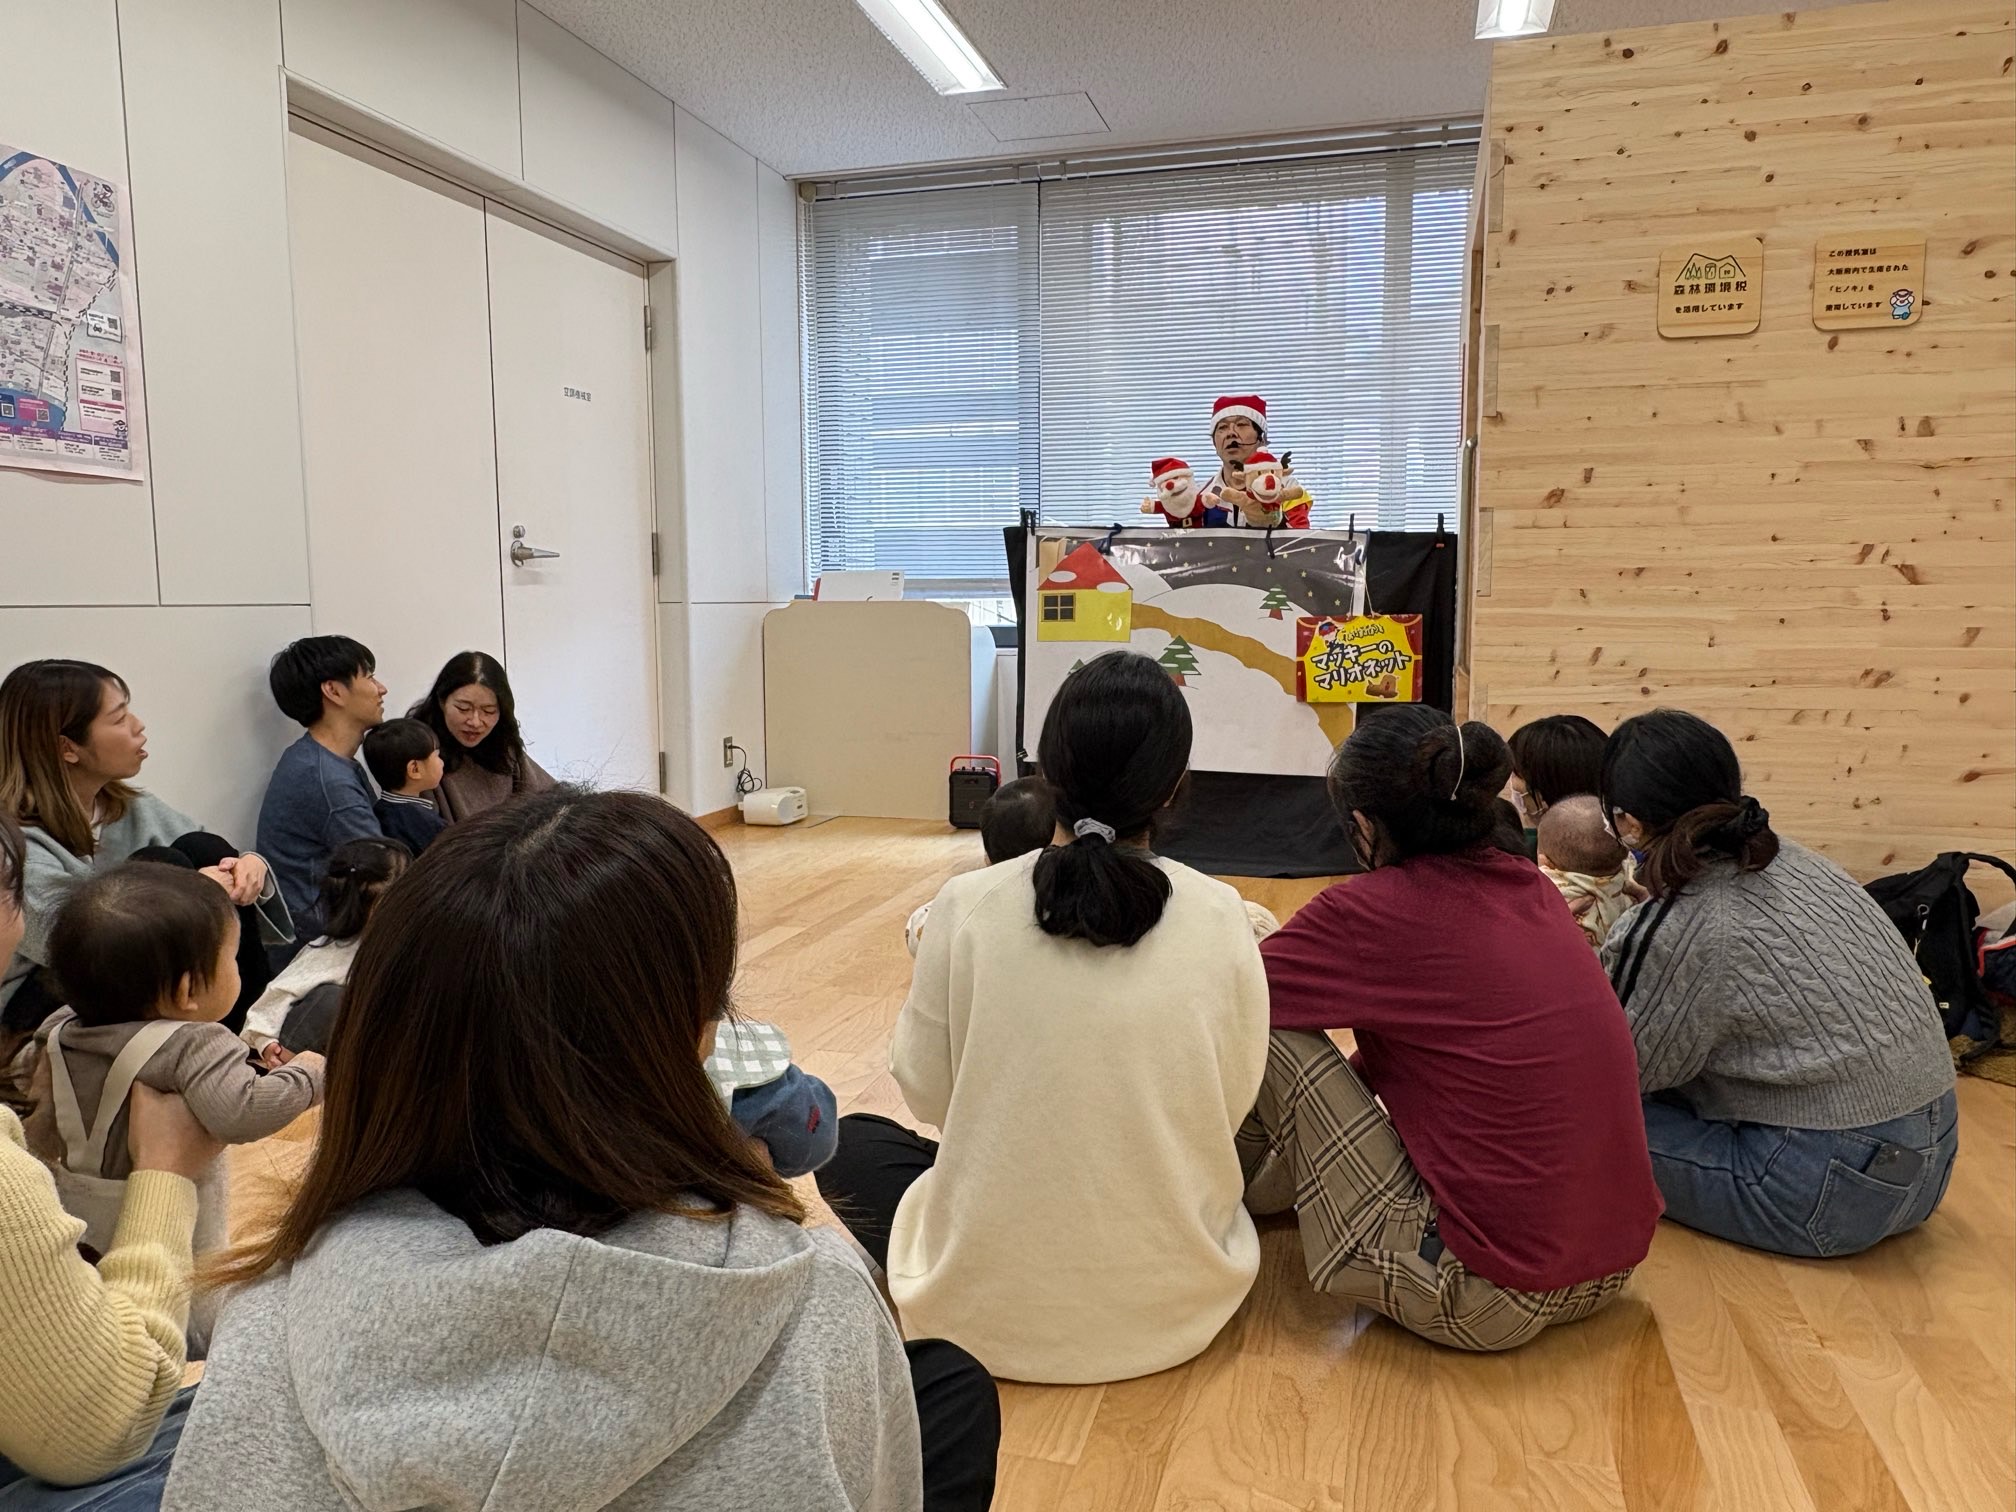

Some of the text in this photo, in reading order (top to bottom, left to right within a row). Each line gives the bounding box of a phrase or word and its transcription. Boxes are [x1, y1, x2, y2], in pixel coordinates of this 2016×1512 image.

[1311, 640, 1394, 671] マッキーの
[1313, 650, 1412, 690] マリオネット
